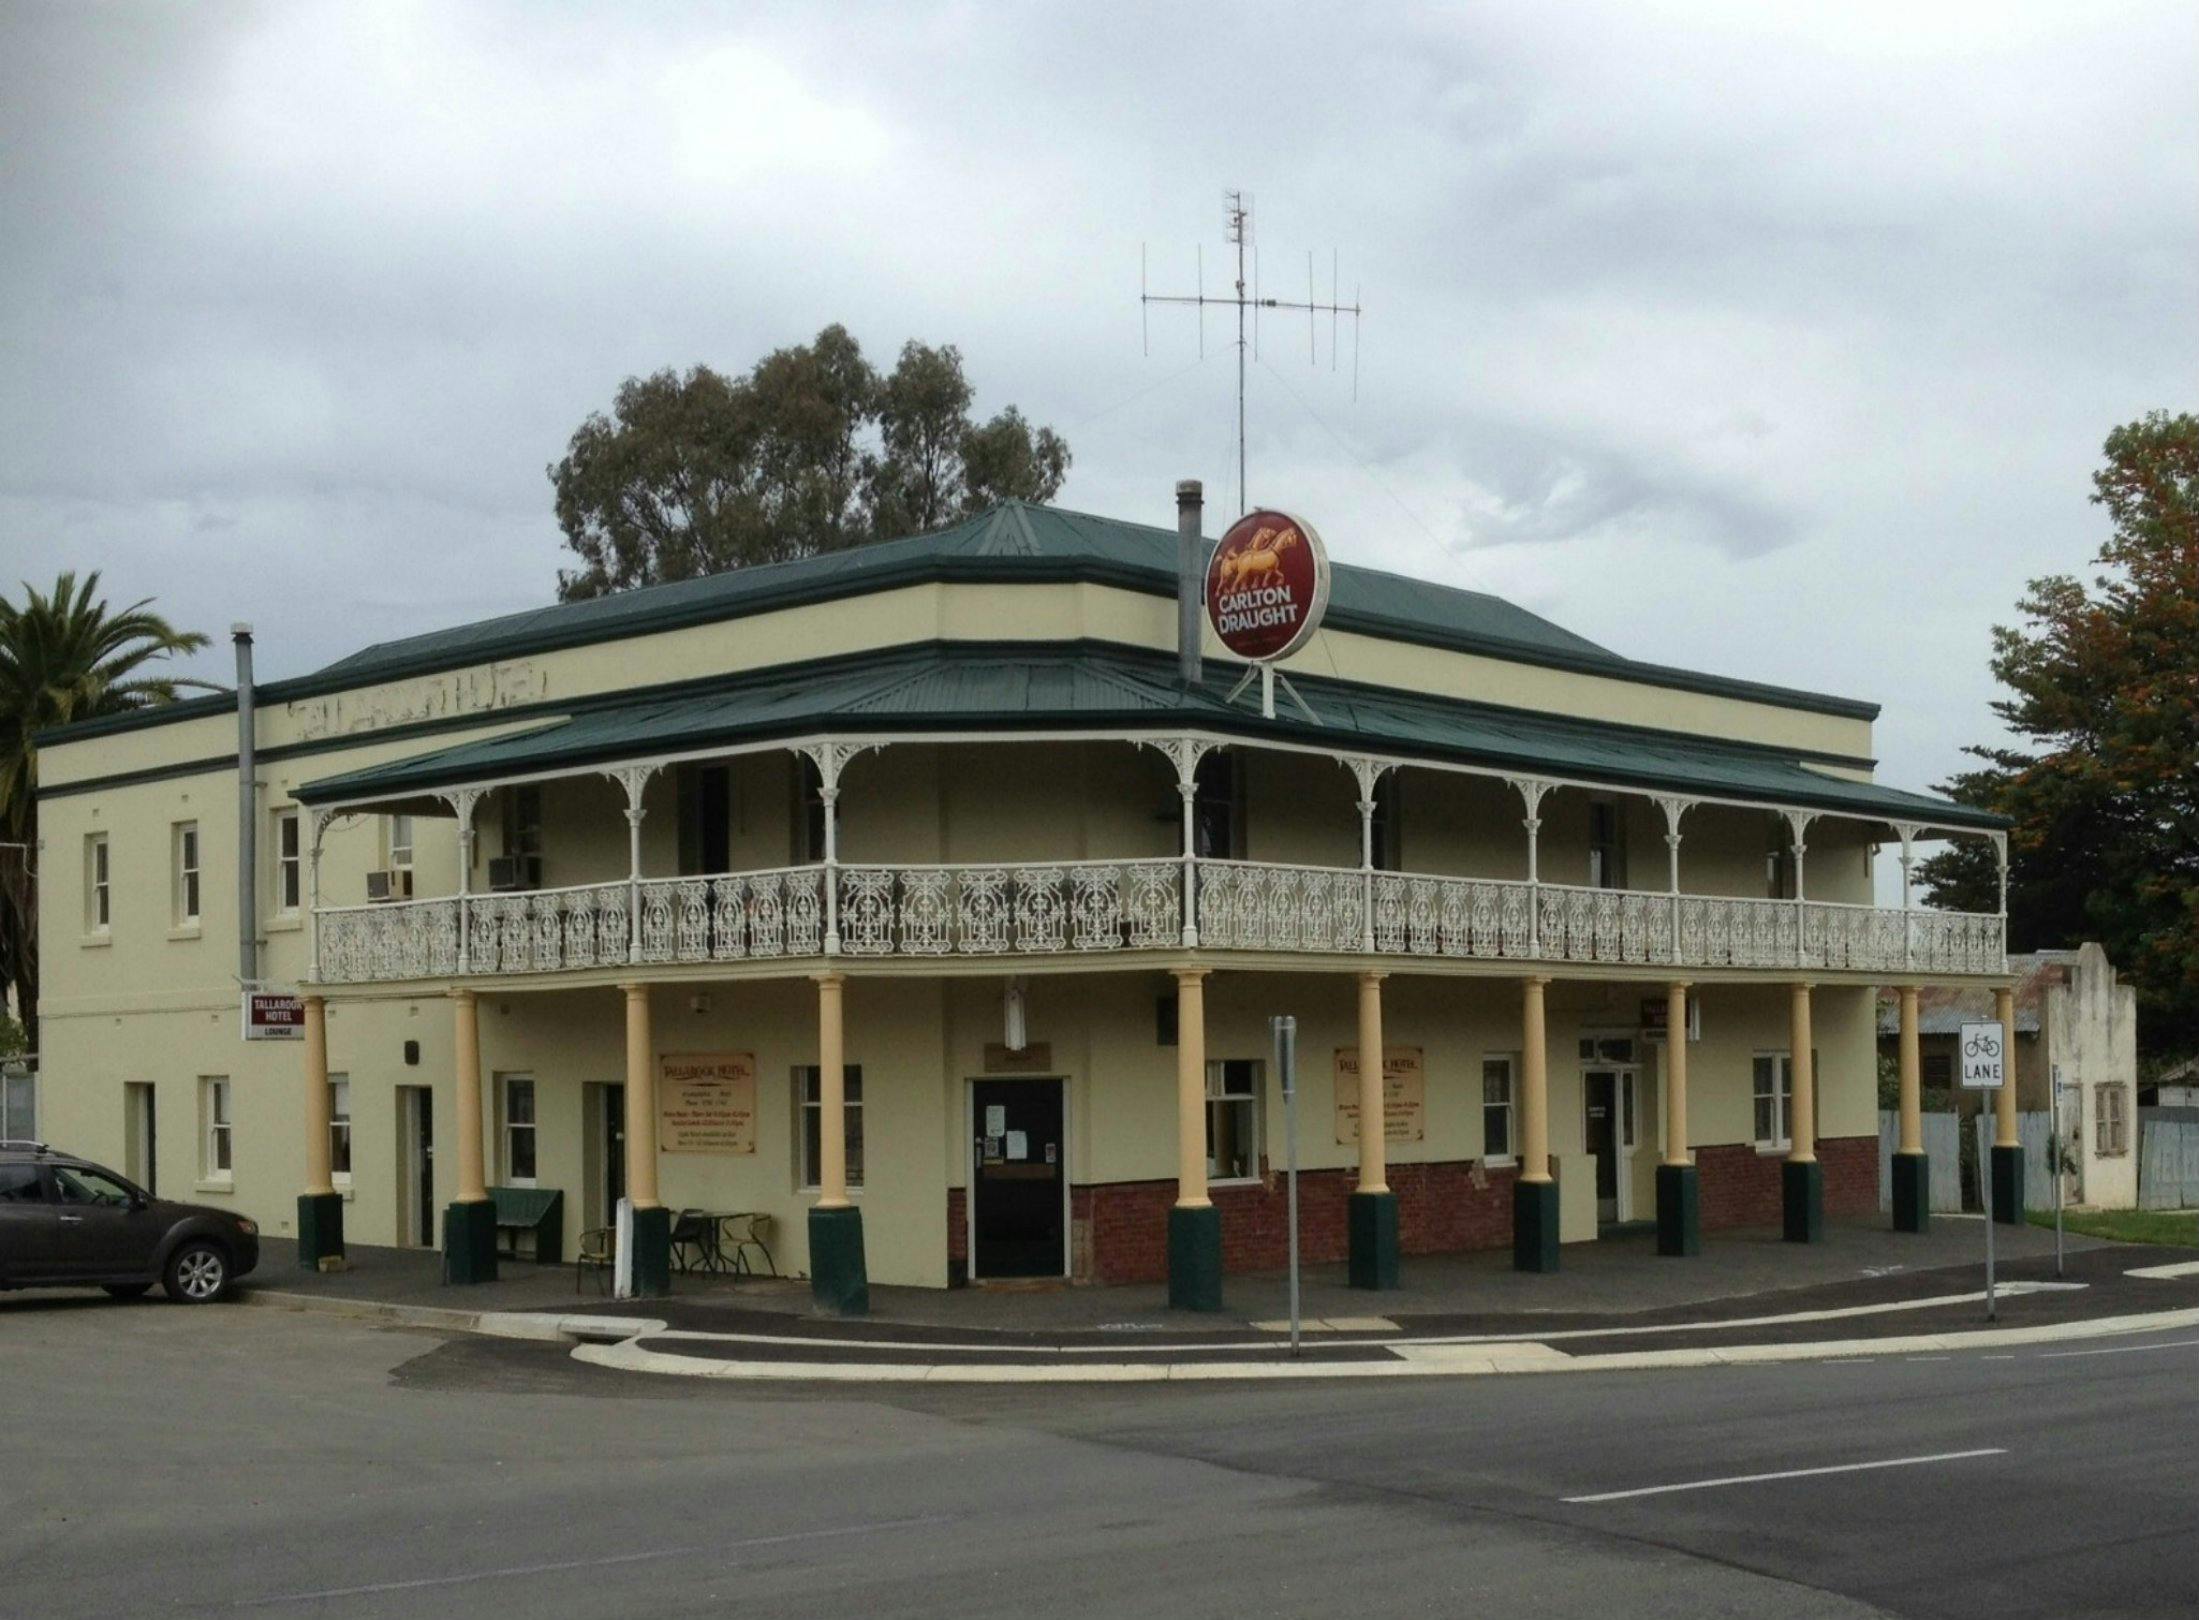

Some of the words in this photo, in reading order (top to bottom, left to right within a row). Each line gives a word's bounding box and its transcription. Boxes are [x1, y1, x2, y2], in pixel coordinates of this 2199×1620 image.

[1219, 585, 1291, 614] CARLTON
[1218, 604, 1298, 634] DRAUGHT
[265, 1011, 292, 1021] HOTEL
[264, 1027, 292, 1036] LOUNGE
[1964, 1064, 2001, 1079] LANE
